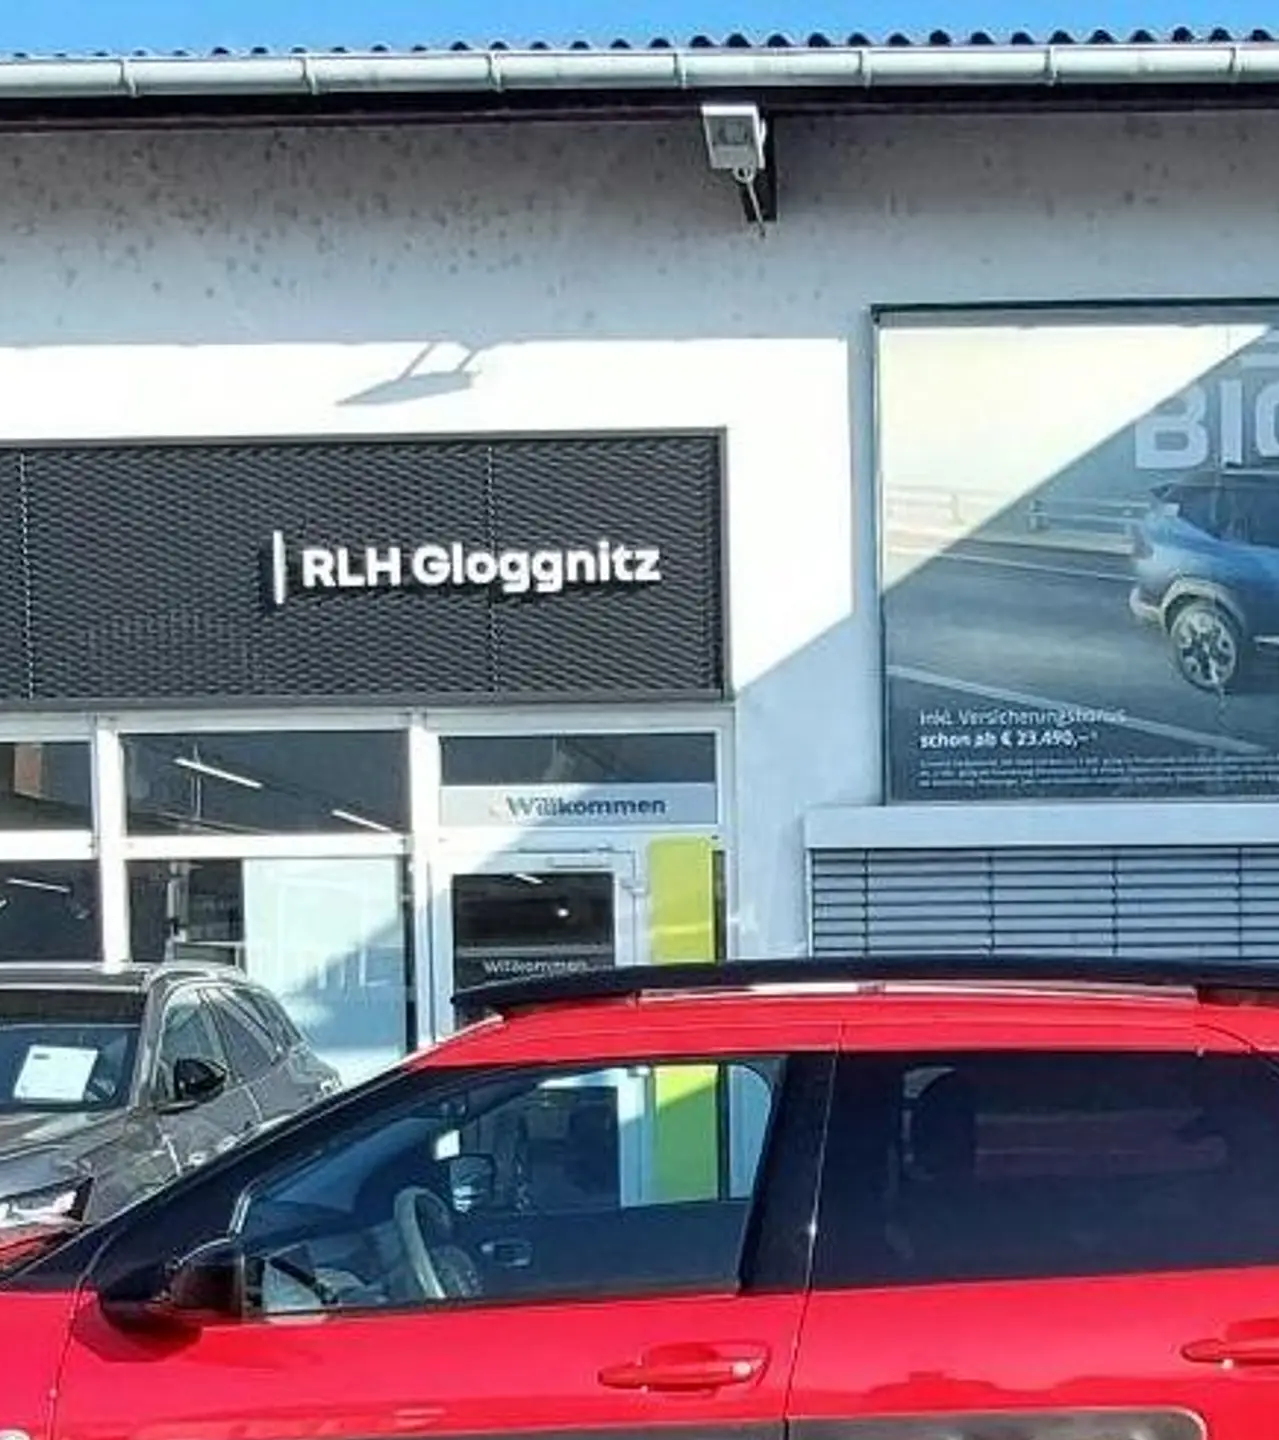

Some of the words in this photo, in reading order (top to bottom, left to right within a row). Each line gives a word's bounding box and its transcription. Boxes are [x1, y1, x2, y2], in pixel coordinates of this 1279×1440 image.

[302, 545, 402, 588] RLH
[412, 538, 662, 593] Gloggnitz
[920, 732, 971, 748] schon
[506, 796, 667, 818] Willkommen
